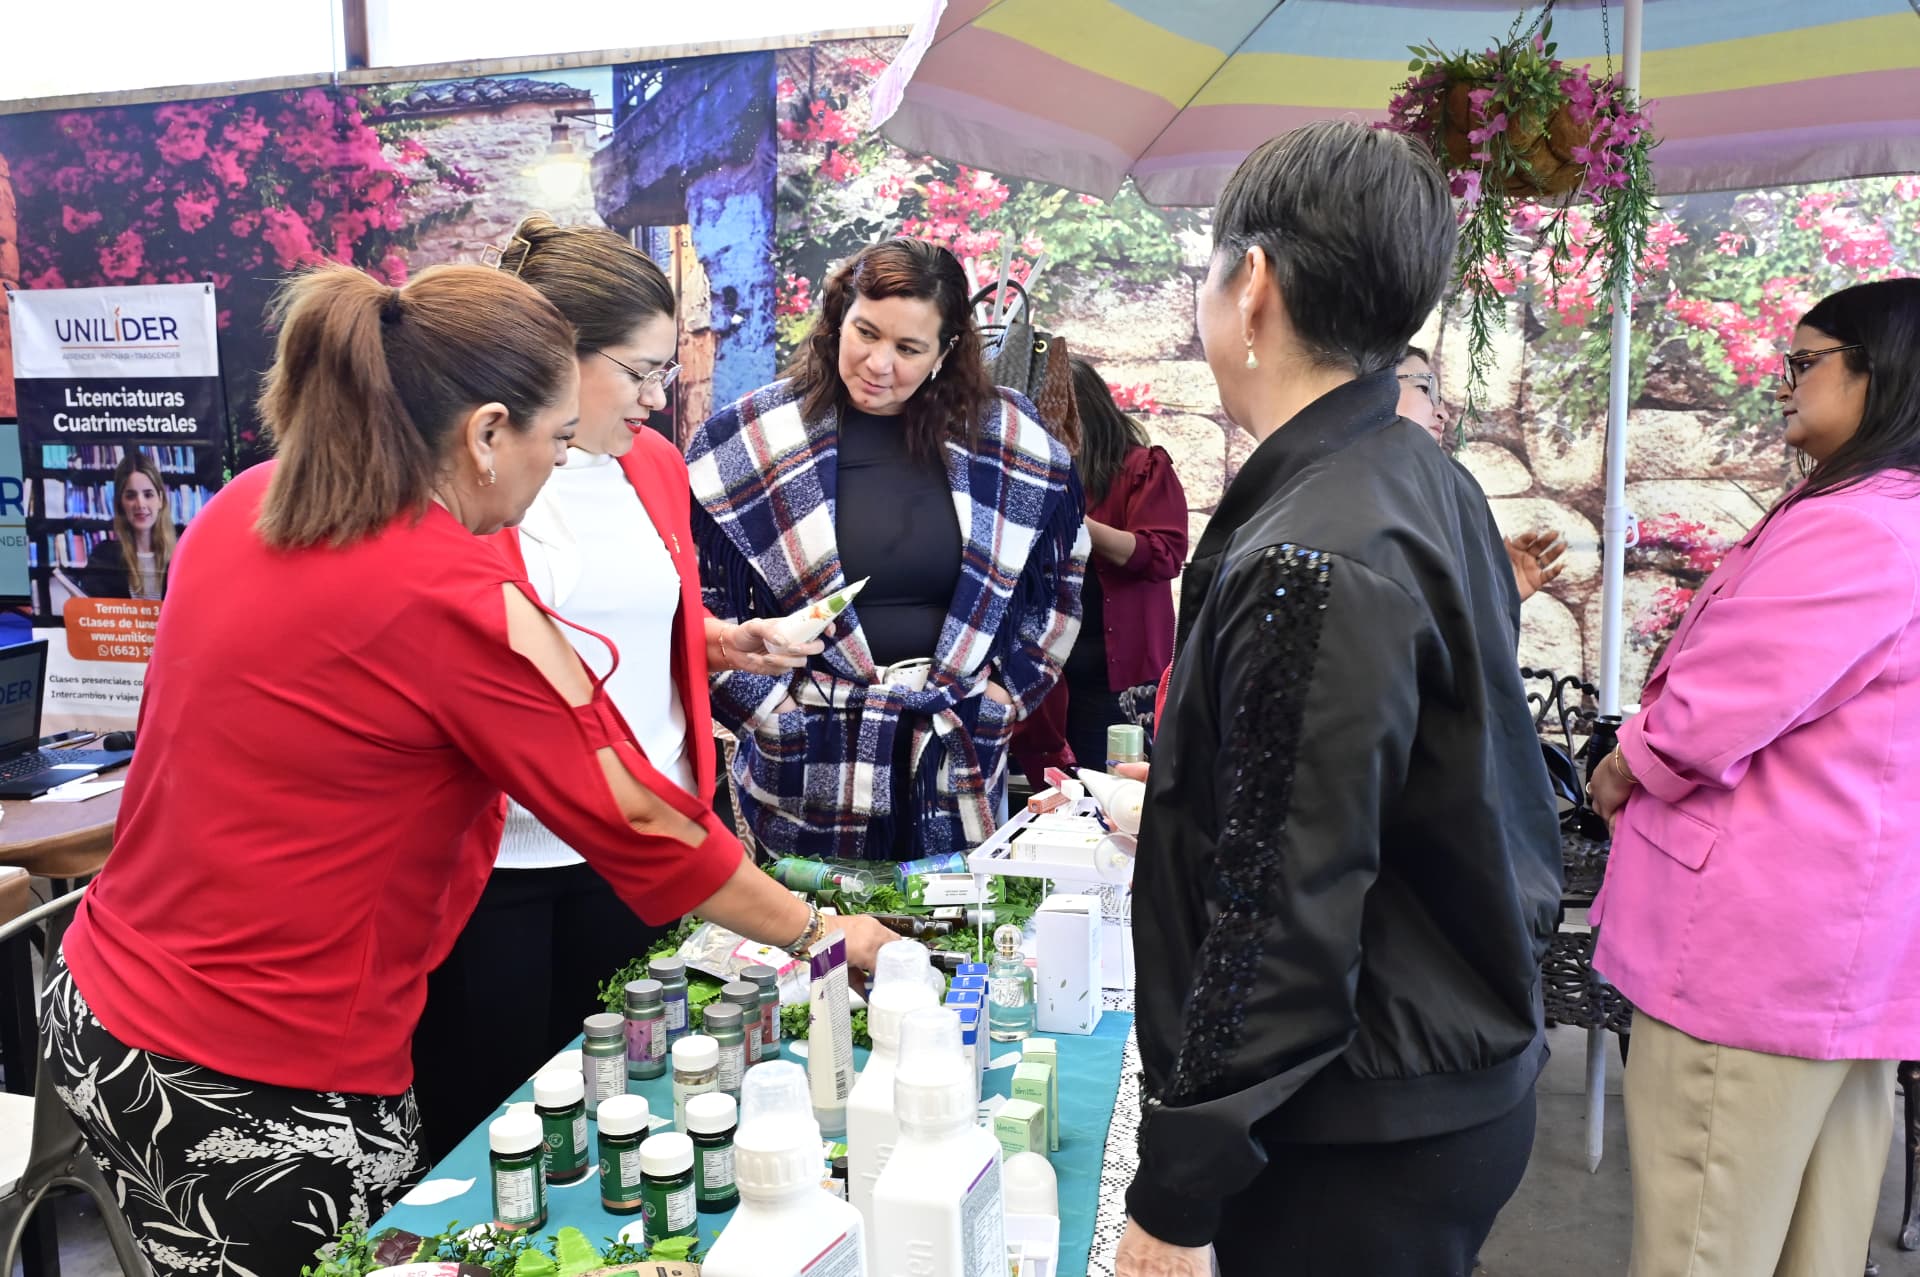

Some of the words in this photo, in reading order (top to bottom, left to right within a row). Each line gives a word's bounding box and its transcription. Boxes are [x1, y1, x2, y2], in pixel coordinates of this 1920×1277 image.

[65, 386, 185, 407] Licenciaturas
[53, 411, 197, 432] Cuatrimestrales
[94, 603, 137, 614] Termina
[141, 607, 151, 615] en
[79, 617, 115, 628] Clases
[119, 618, 132, 628] de
[110, 645, 140, 658] (662)
[49, 675, 79, 683] Clases
[82, 676, 131, 686] presenciales
[51, 690, 106, 699] Intercambios
[117, 692, 139, 702] viajes
